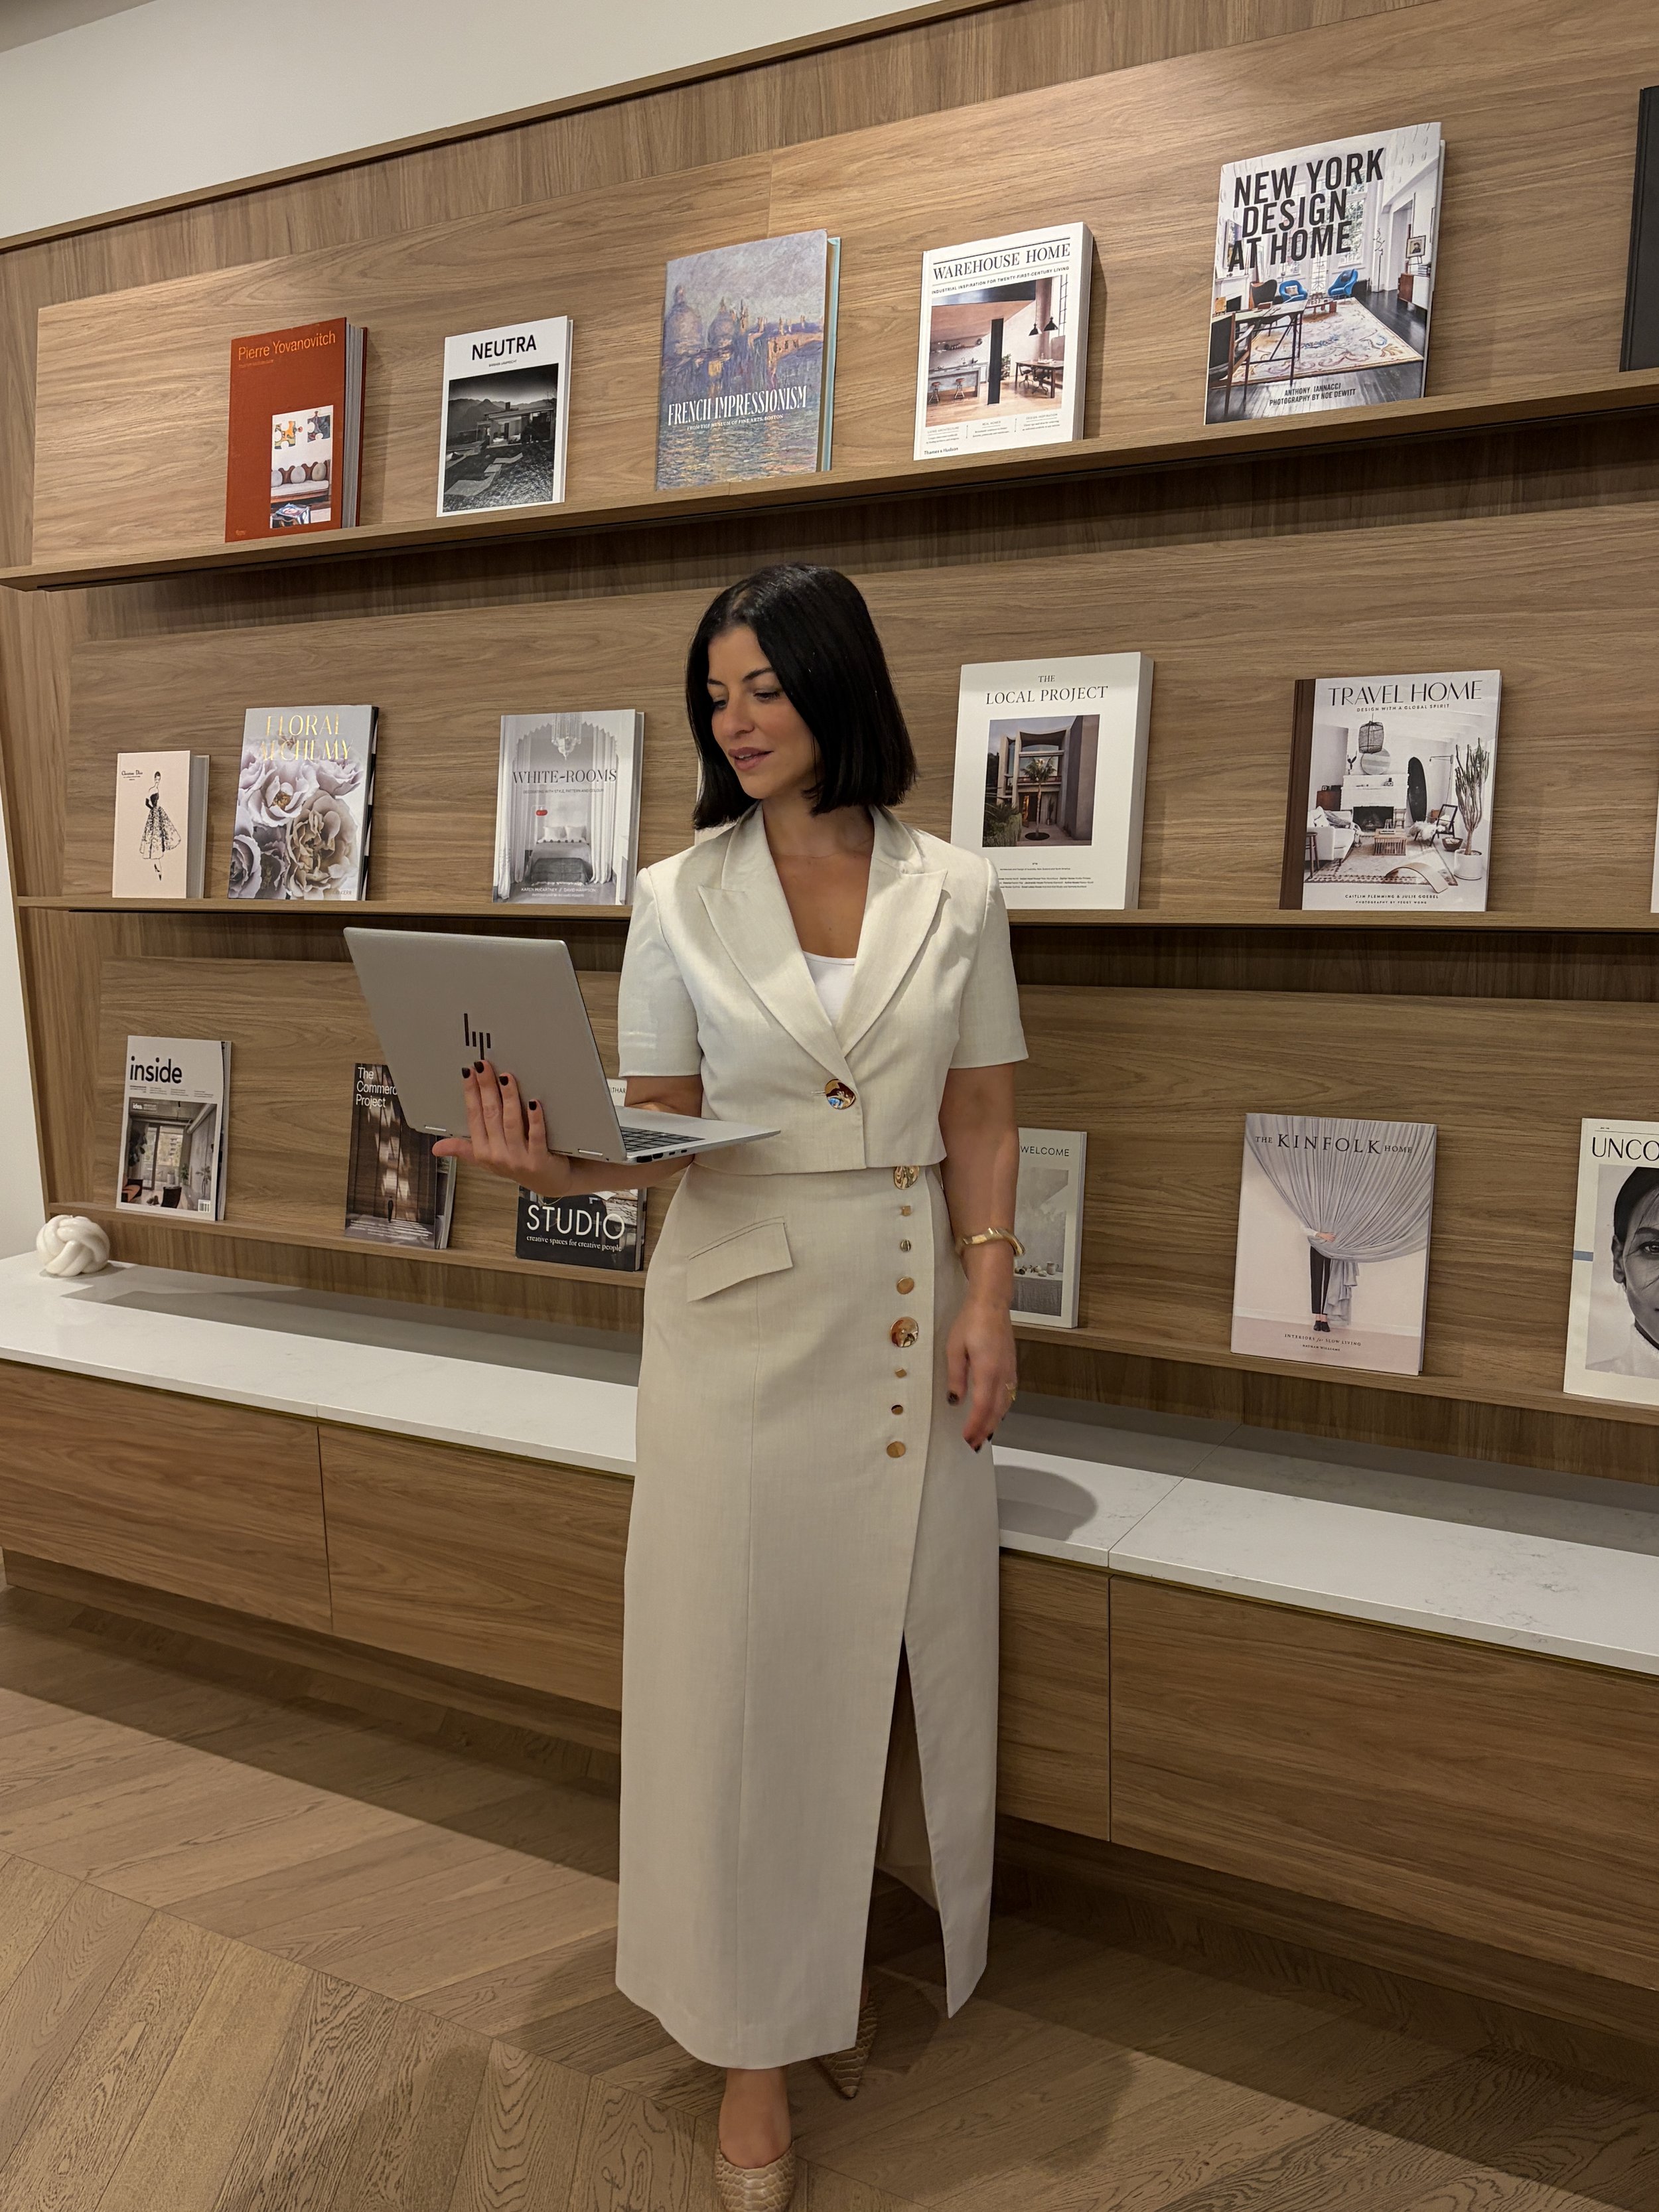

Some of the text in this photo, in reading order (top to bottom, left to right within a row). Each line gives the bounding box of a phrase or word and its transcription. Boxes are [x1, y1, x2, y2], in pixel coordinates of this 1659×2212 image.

[1234, 147, 1385, 208] NEW YORK
[1242, 188, 1347, 238] DESIGN
[1228, 221, 1352, 272] AT HOME
[933, 243, 1070, 280] WAREHOUSE HOME
[958, 281, 986, 290] INSPIRATION
[997, 269, 1052, 283] TWENTY-FIRST-CENTURY
[238, 331, 336, 360] Pierre Yovanovitch
[472, 334, 537, 360] NEUTRA
[1269, 394, 1311, 406] PHOTOGRAPHY
[1334, 388, 1356, 398] DEWITT
[1284, 382, 1341, 396] ANTHONY IANNACCI
[668, 385, 807, 426] FRENCH IMPRESSIONISM
[1038, 674, 1056, 683] THE
[985, 686, 1108, 705] LOCAL PROJECT
[1328, 680, 1483, 706] TRAVEL HOME
[512, 769, 617, 784] WHITE-ROOMS
[129, 1056, 182, 1084] inside
[358, 1067, 374, 1079] The
[356, 1094, 386, 1109] Project
[1020, 1145, 1070, 1157] WELCOME
[1277, 1133, 1382, 1155] KINFOLK
[1384, 1145, 1413, 1153] HOME
[1593, 1137, 1659, 1161] UNCO
[526, 1205, 625, 1240] STUDIO
